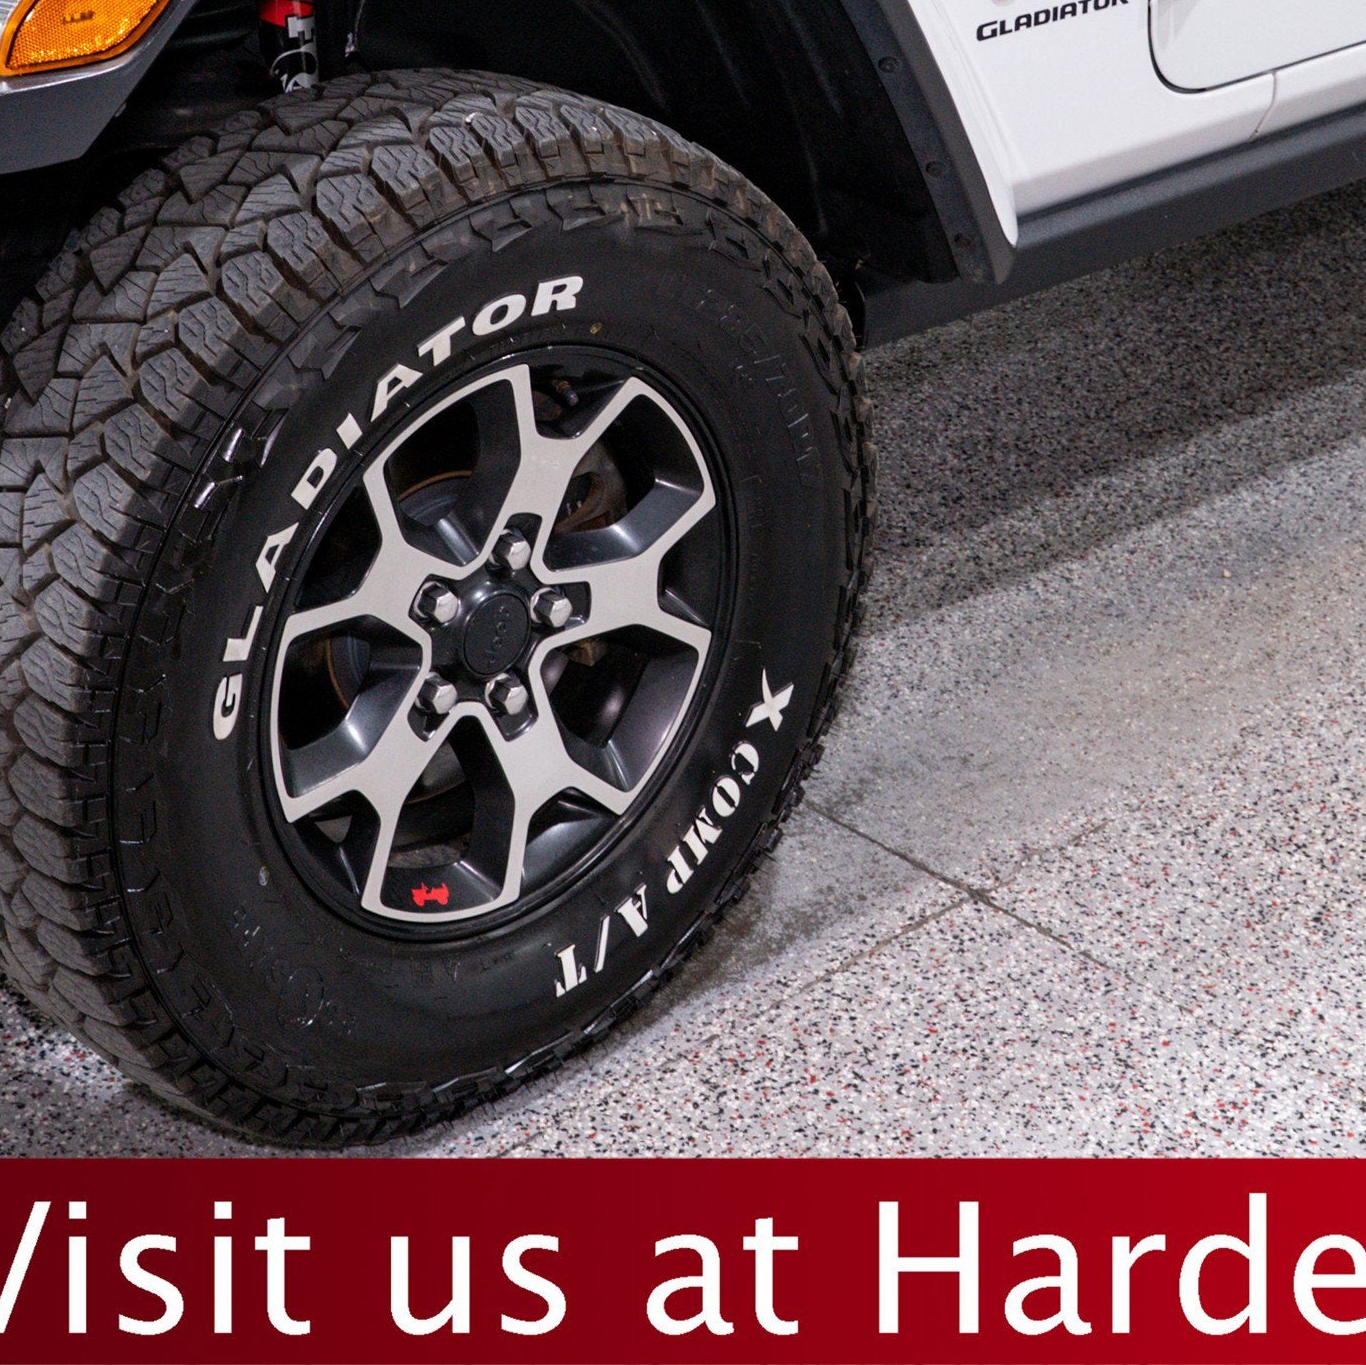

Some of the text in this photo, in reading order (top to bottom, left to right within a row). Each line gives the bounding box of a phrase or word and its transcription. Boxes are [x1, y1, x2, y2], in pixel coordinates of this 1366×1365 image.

[211, 275, 585, 741] GLADIATOR
[665, 739, 761, 896] COMP
[554, 883, 649, 999] A/T
